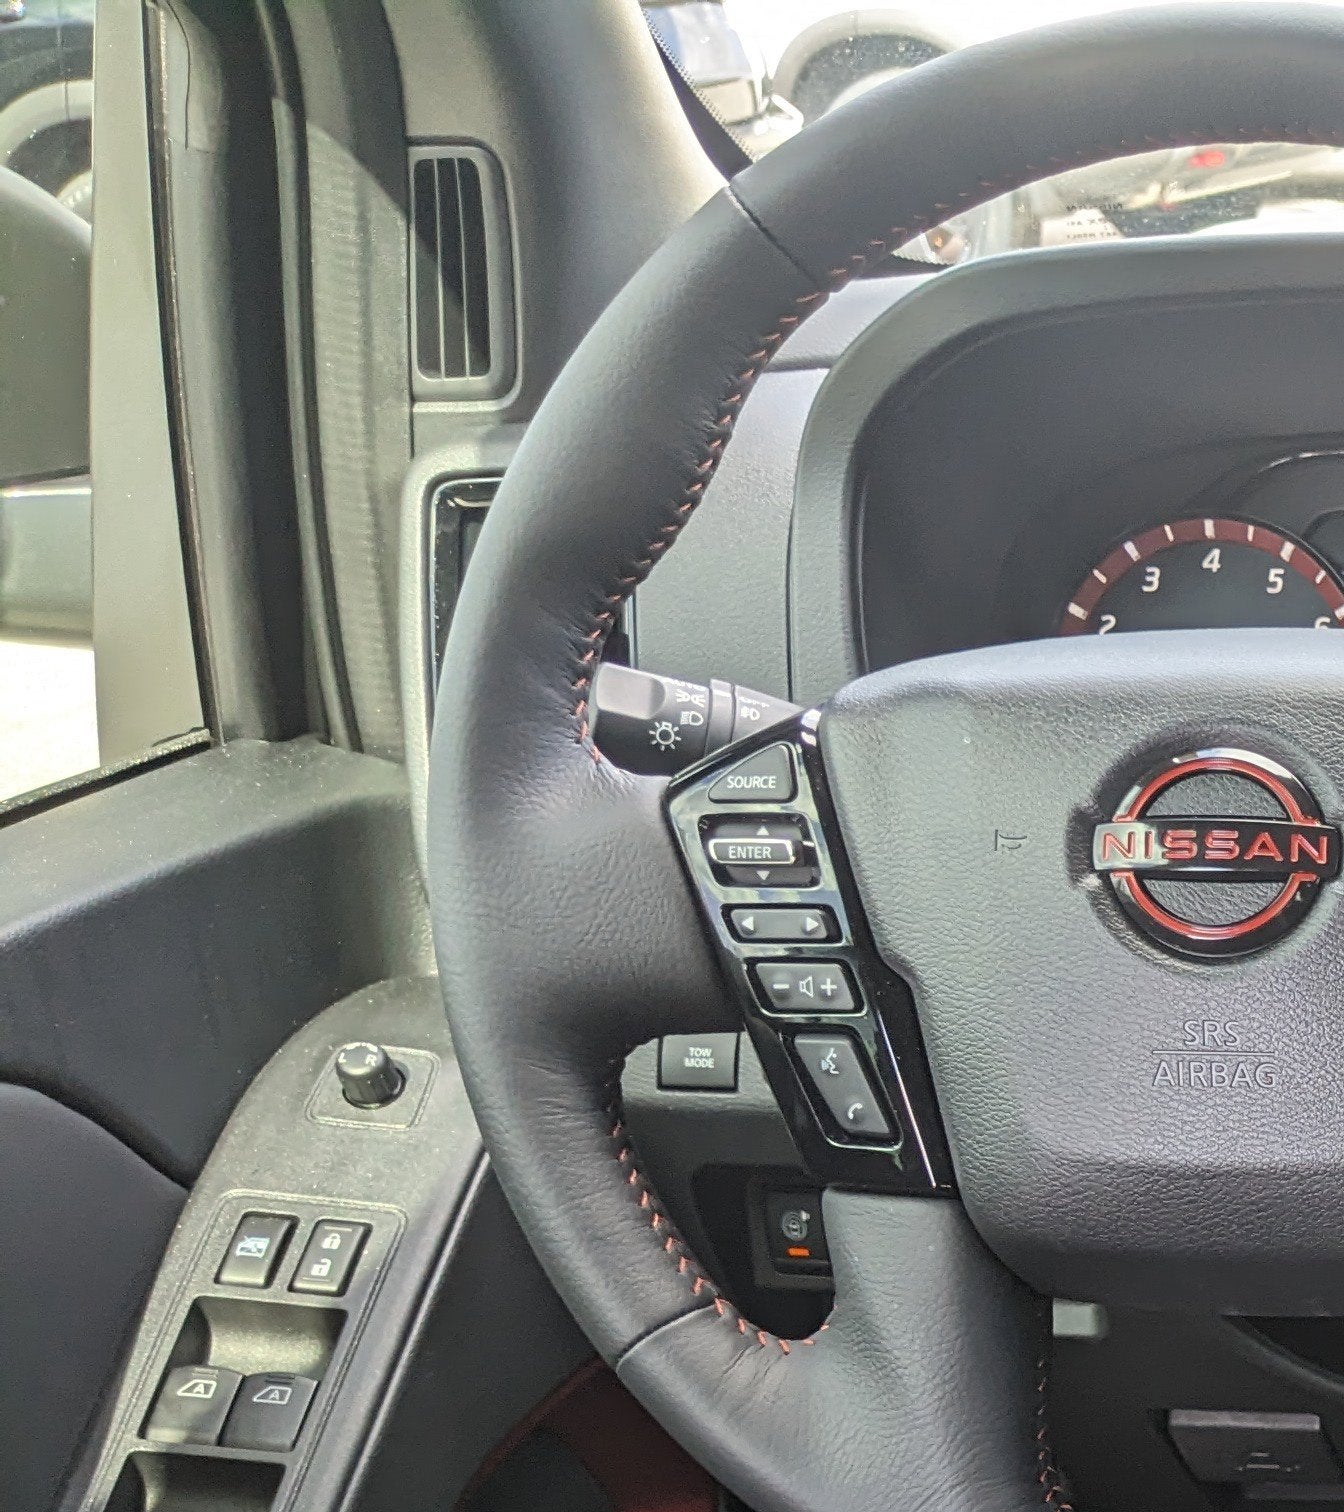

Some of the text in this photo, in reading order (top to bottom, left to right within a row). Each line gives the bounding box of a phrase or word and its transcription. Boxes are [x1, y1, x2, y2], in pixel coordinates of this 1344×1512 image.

[1201, 548, 1222, 573] 4
[1141, 566, 1162, 593] 3
[1266, 568, 1286, 595] 5
[726, 774, 777, 791] SOURCE
[728, 844, 772, 860] ENTER
[1102, 829, 1329, 865] NISSAN
[1182, 1019, 1240, 1048] SRS
[684, 1057, 715, 1069] MODE
[688, 1046, 712, 1058] TOW
[1152, 1060, 1277, 1089] AIRBAG
